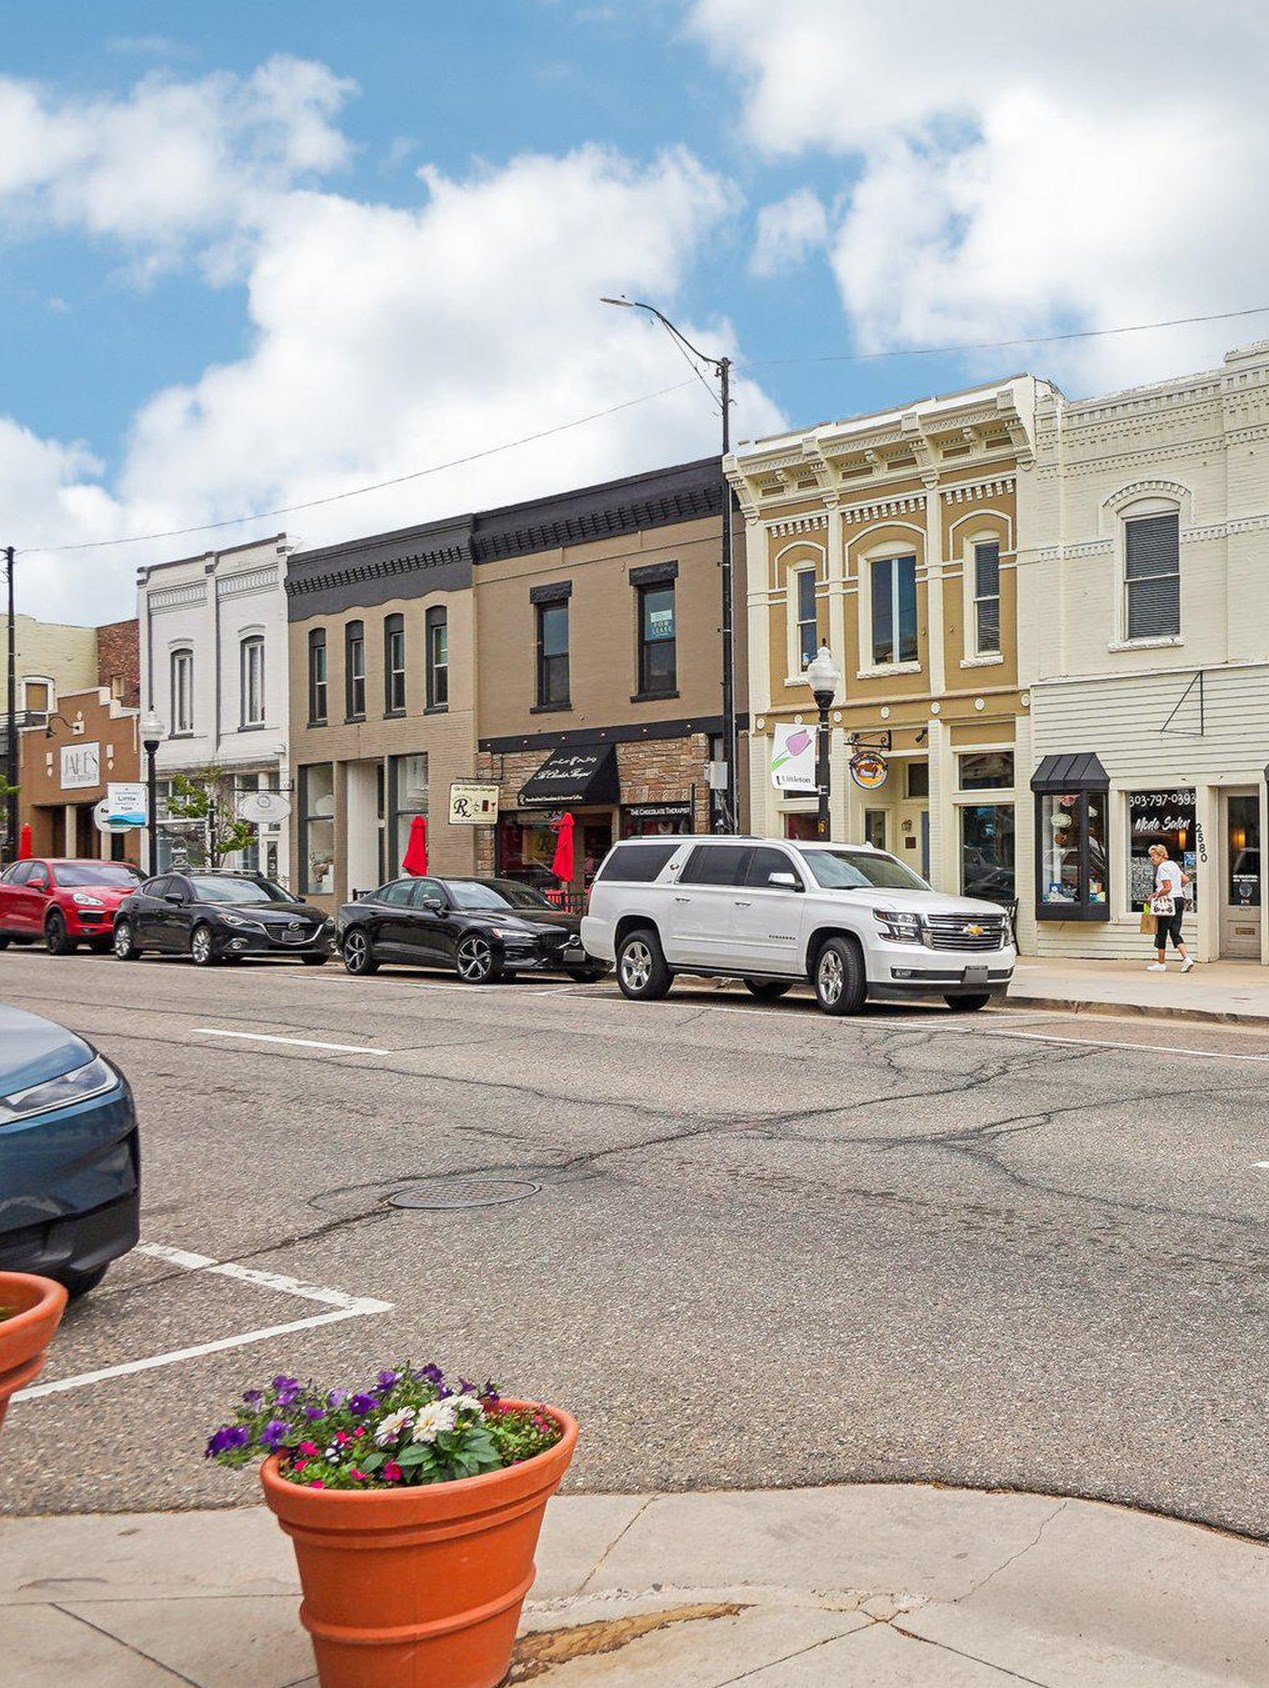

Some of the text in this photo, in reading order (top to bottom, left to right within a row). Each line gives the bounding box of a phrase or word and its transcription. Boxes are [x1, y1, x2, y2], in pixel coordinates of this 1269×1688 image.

[1128, 792, 1197, 808] 303-797-0393
[1134, 816, 1161, 832] Mode
[1195, 822, 1208, 863] 2580
